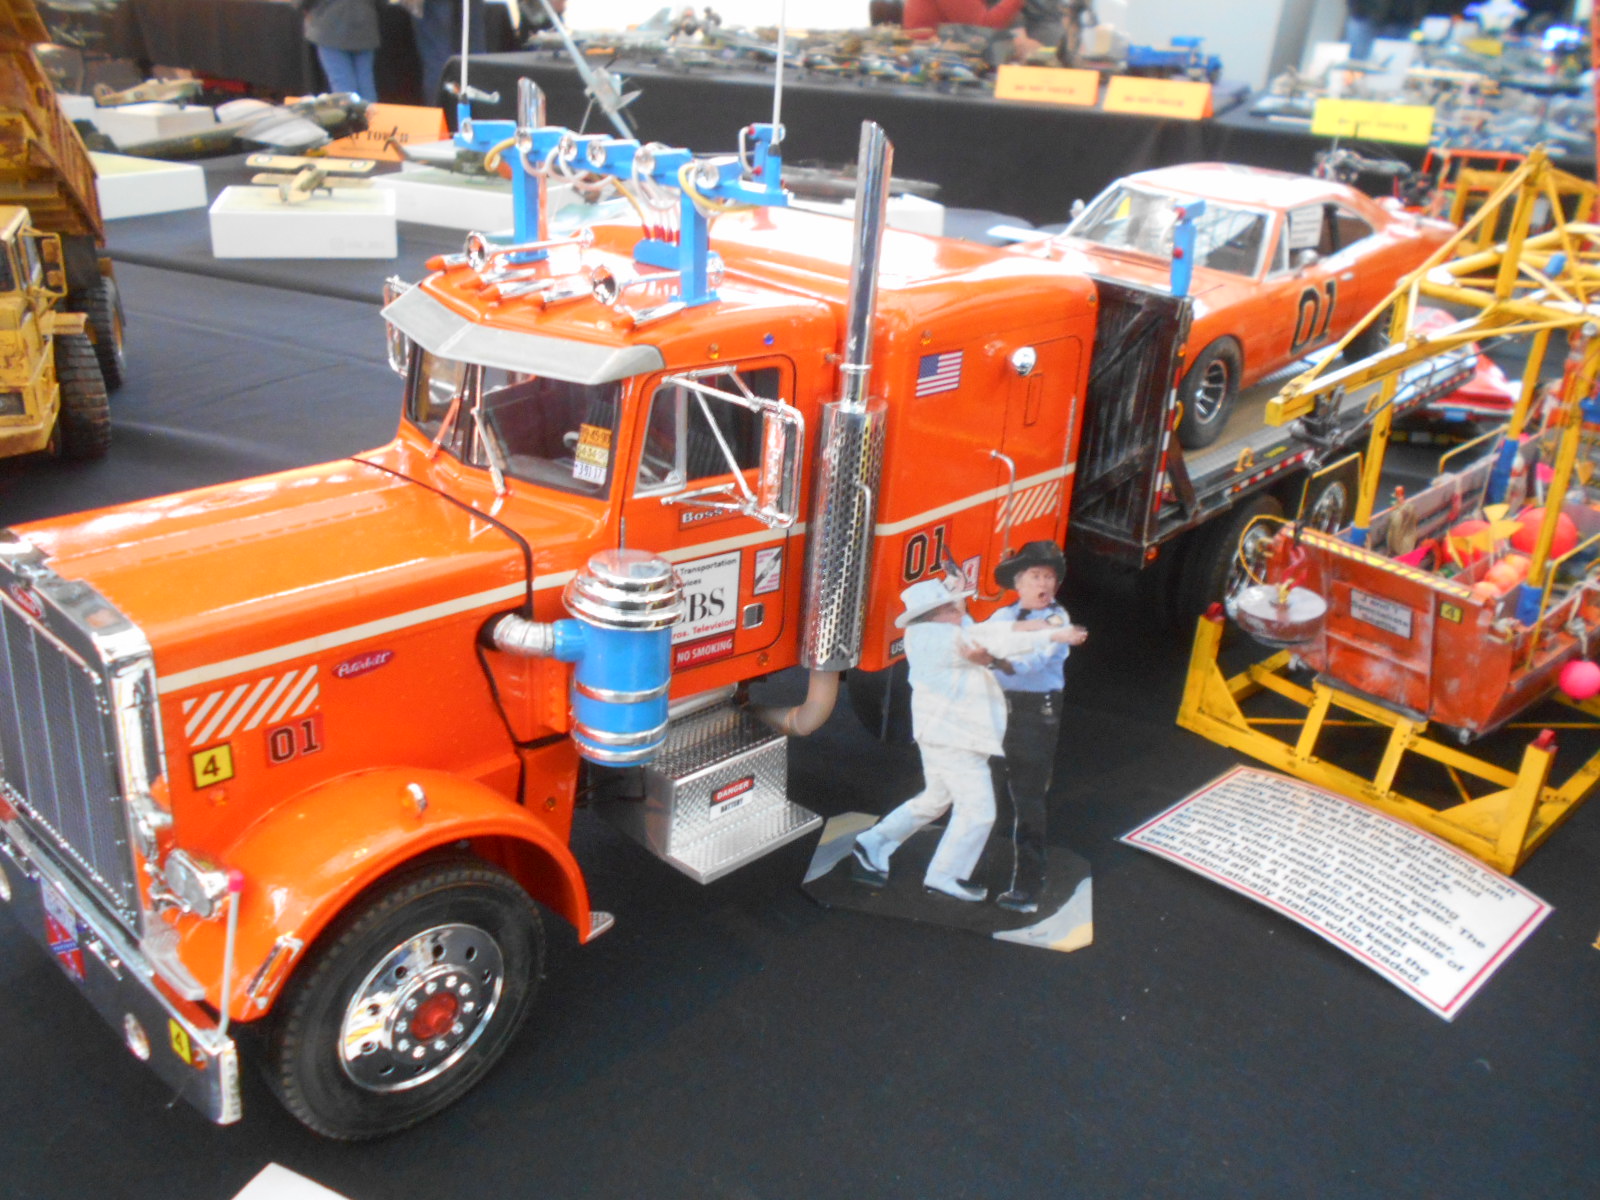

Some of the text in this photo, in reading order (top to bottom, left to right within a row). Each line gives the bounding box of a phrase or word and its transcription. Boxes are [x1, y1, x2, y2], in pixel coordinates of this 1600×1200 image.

[1290, 279, 1336, 355] 01
[681, 508, 723, 524] Boss
[680, 558, 737, 575] Transportation
[903, 525, 945, 583] 01
[676, 638, 733, 663] NO SMOKING
[693, 619, 736, 634] Television
[202, 754, 221, 777] 4
[269, 719, 321, 764] 01
[716, 779, 750, 800] DANGER
[1183, 808, 1238, 827] Landing
[1238, 825, 1273, 841] Craft
[1289, 846, 1331, 869] easily
[1333, 867, 1418, 917] transported
[1269, 795, 1309, 810] added
[1393, 846, 1450, 879] delivery
[1287, 809, 1336, 831] project
[1338, 829, 1404, 864] boundary
[1308, 800, 1340, 813] have
[1353, 818, 1430, 857] lightweight
[1434, 856, 1504, 901] aluminum
[1327, 834, 1396, 870] numerous
[1400, 870, 1437, 893] other
[1148, 829, 1178, 840] tank
[1178, 840, 1229, 862] located
[1282, 885, 1345, 923] installed
[1365, 932, 1402, 958] keep
[1196, 829, 1239, 847] gantry
[1290, 867, 1344, 897] electric
[1345, 896, 1383, 920] hoist
[1385, 919, 1445, 960] capable
[1240, 835, 1278, 853] when
[1280, 852, 1331, 879] needed
[1368, 897, 1406, 922] truck
[1408, 921, 1457, 954] trailer.
[1263, 826, 1319, 853] projects
[1339, 859, 1407, 898] shallower
[1411, 898, 1455, 928] water.
[1297, 830, 1335, 849] items
[1337, 848, 1376, 870] when
[1377, 869, 1459, 919] conducting
[1419, 838, 1478, 873] Landing
[1480, 872, 1516, 897] Craft
[1278, 894, 1322, 921] stable
[1324, 919, 1365, 947] while
[1365, 945, 1424, 985] loaded.
[1308, 887, 1354, 916] gallon
[1357, 914, 1408, 948] ballast
